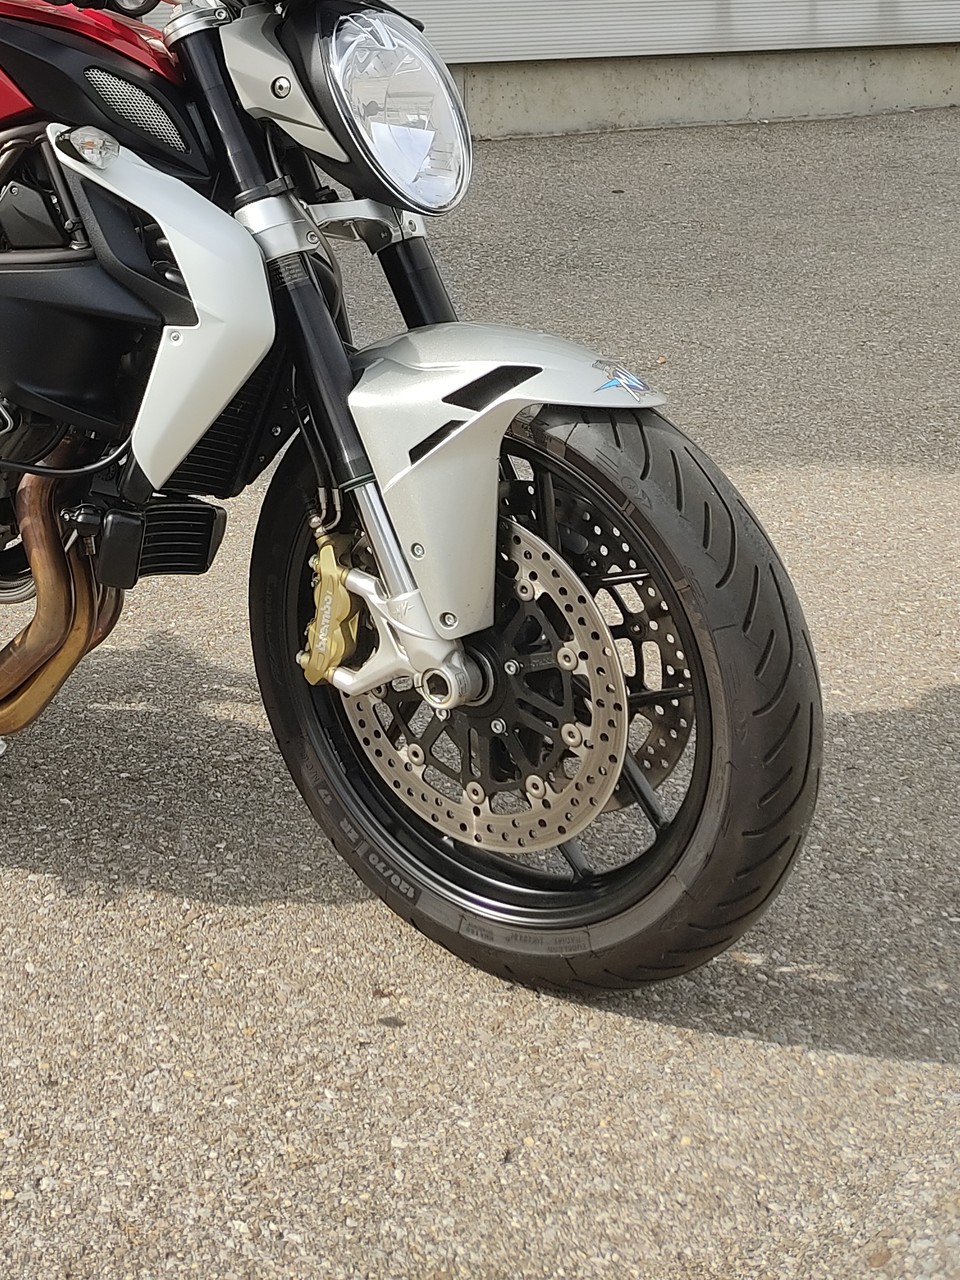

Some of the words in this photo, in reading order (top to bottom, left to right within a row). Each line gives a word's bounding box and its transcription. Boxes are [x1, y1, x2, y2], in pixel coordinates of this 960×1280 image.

[317, 593, 333, 653] brembo
[319, 788, 332, 806] 17
[339, 817, 360, 842] ZR
[368, 853, 415, 897] 120/70
